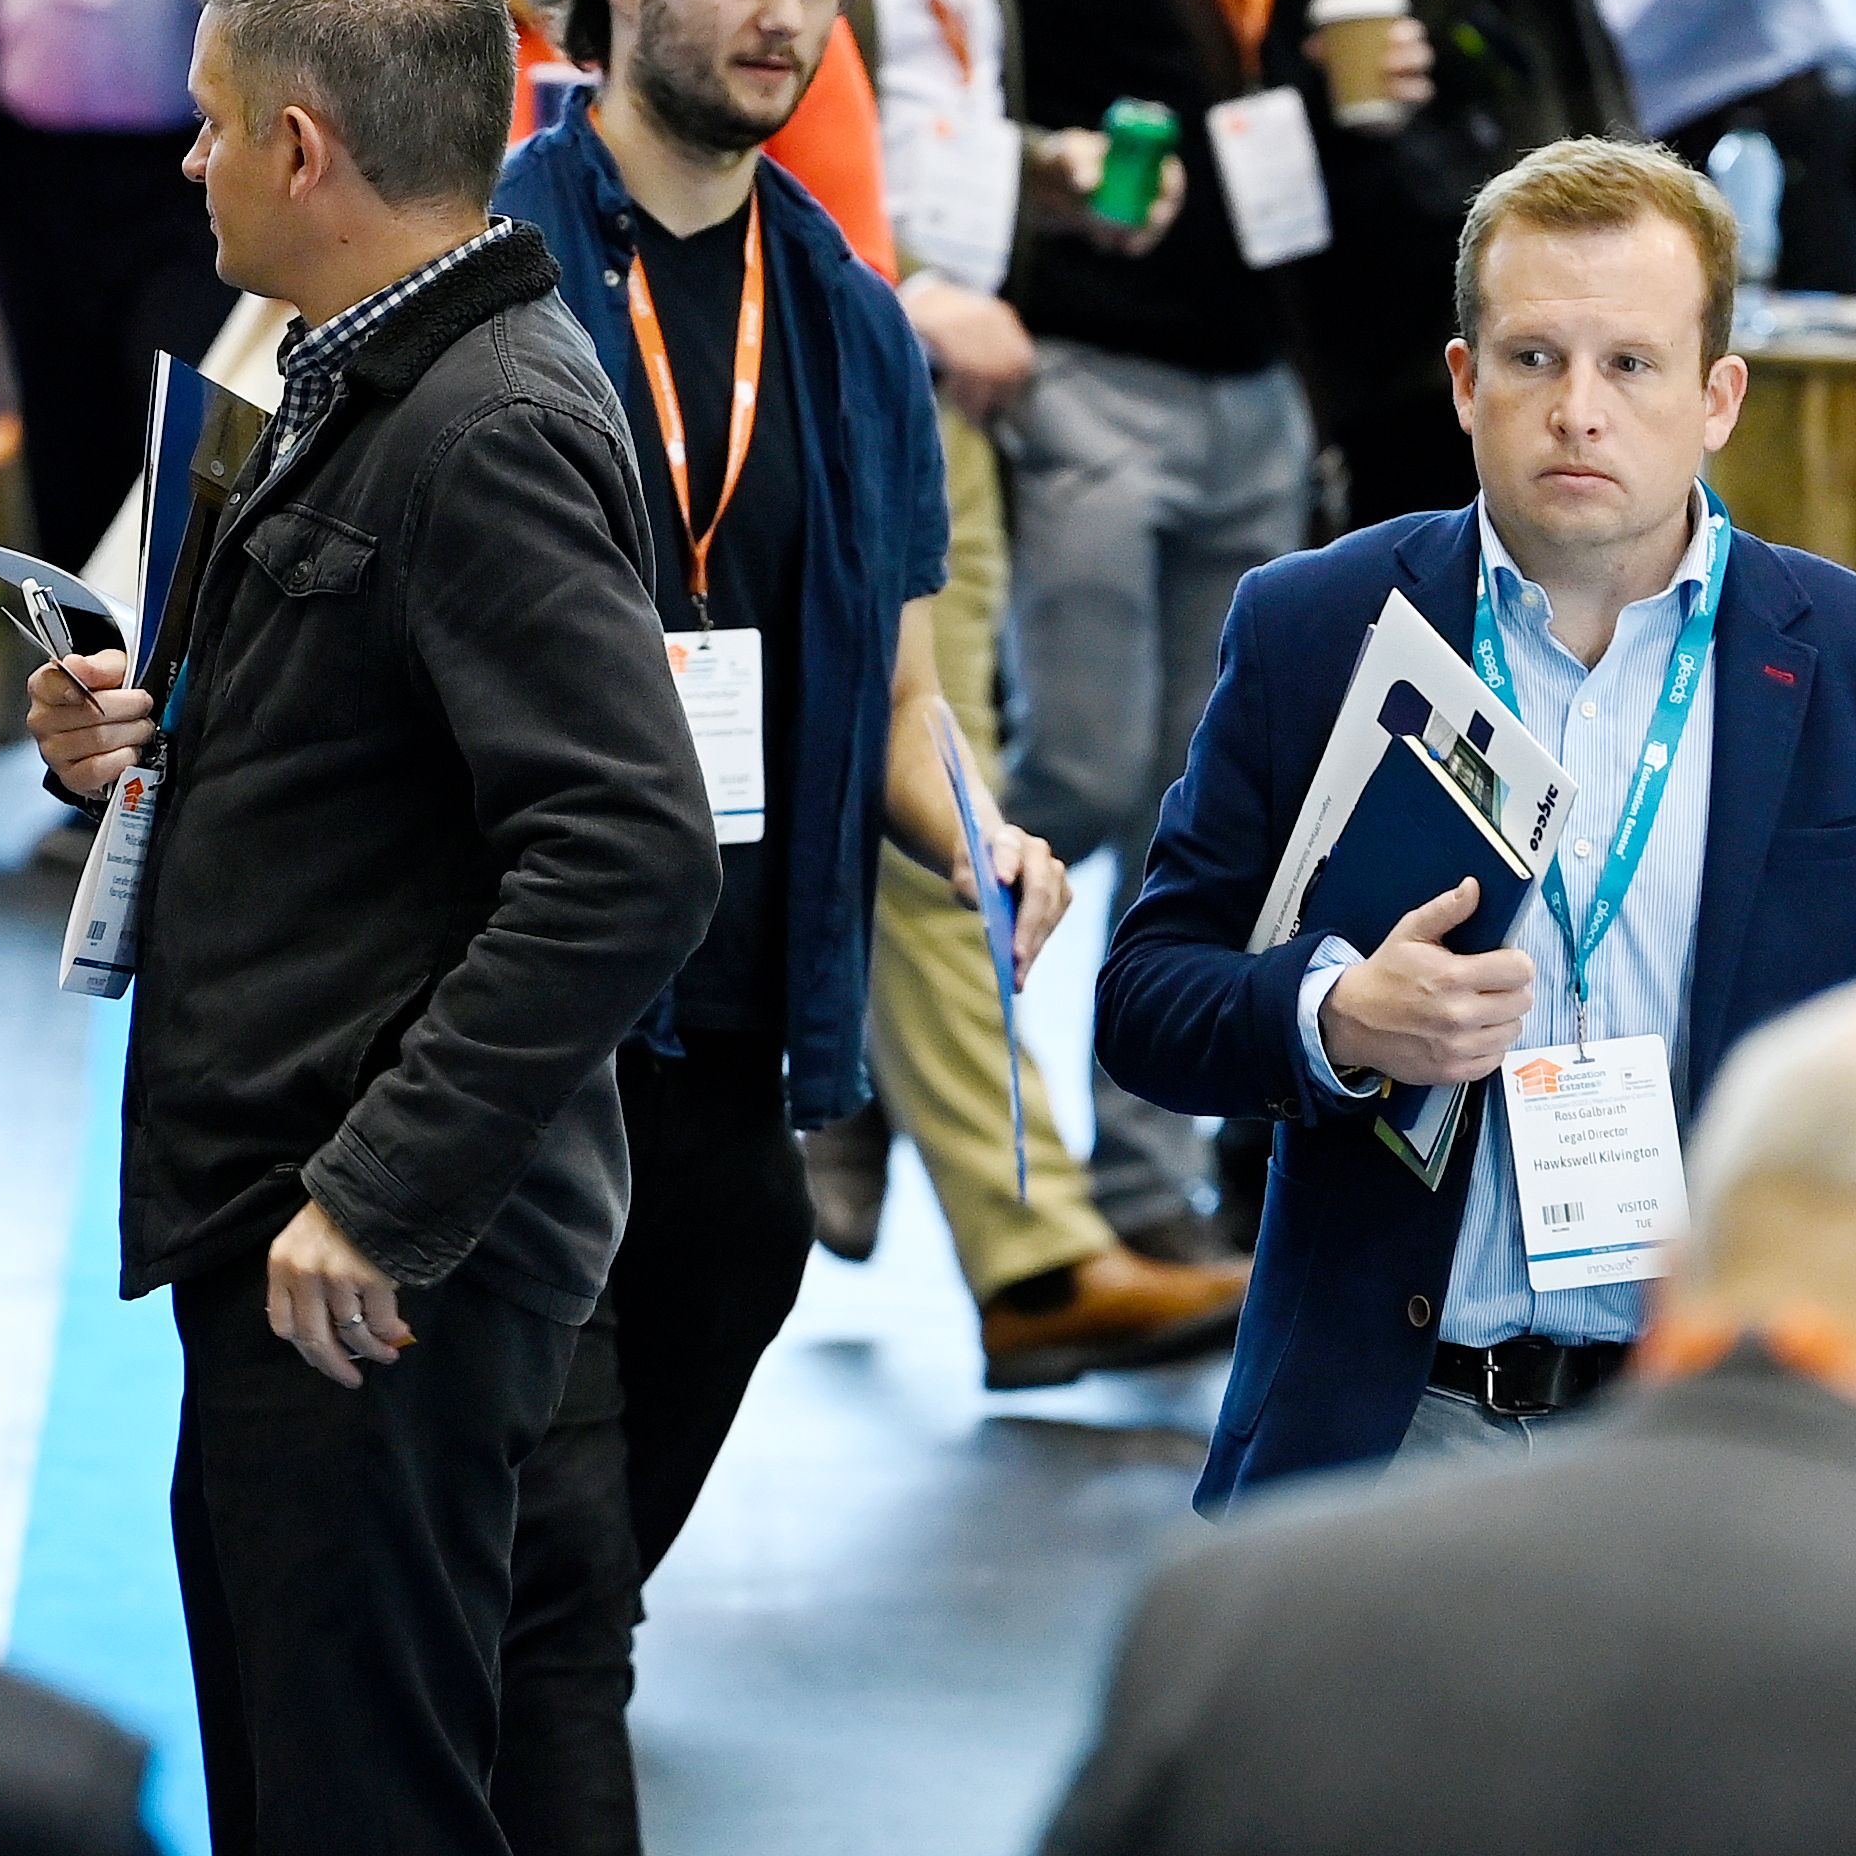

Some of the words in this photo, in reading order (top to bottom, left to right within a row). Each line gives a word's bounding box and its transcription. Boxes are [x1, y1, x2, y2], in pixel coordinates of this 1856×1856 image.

[1477, 638, 1504, 689] gleeds
[1669, 653, 1696, 705] gleeds
[1629, 765, 1651, 815] Education
[1529, 784, 1558, 852] algeco
[1293, 850, 1312, 883] Solutions
[1278, 885, 1298, 923] Permanent
[1557, 1070, 1606, 1082] Education
[1554, 1110, 1577, 1122] Ross
[1578, 1104, 1627, 1119] Galbraith
[1558, 1130, 1587, 1145] Legal
[1587, 1126, 1629, 1140] Director
[1533, 1151, 1598, 1172] Hawkswell
[1598, 1146, 1660, 1164] Kilvington
[1617, 1198, 1660, 1213] VISITOR
[1635, 1218, 1653, 1228] TUE
